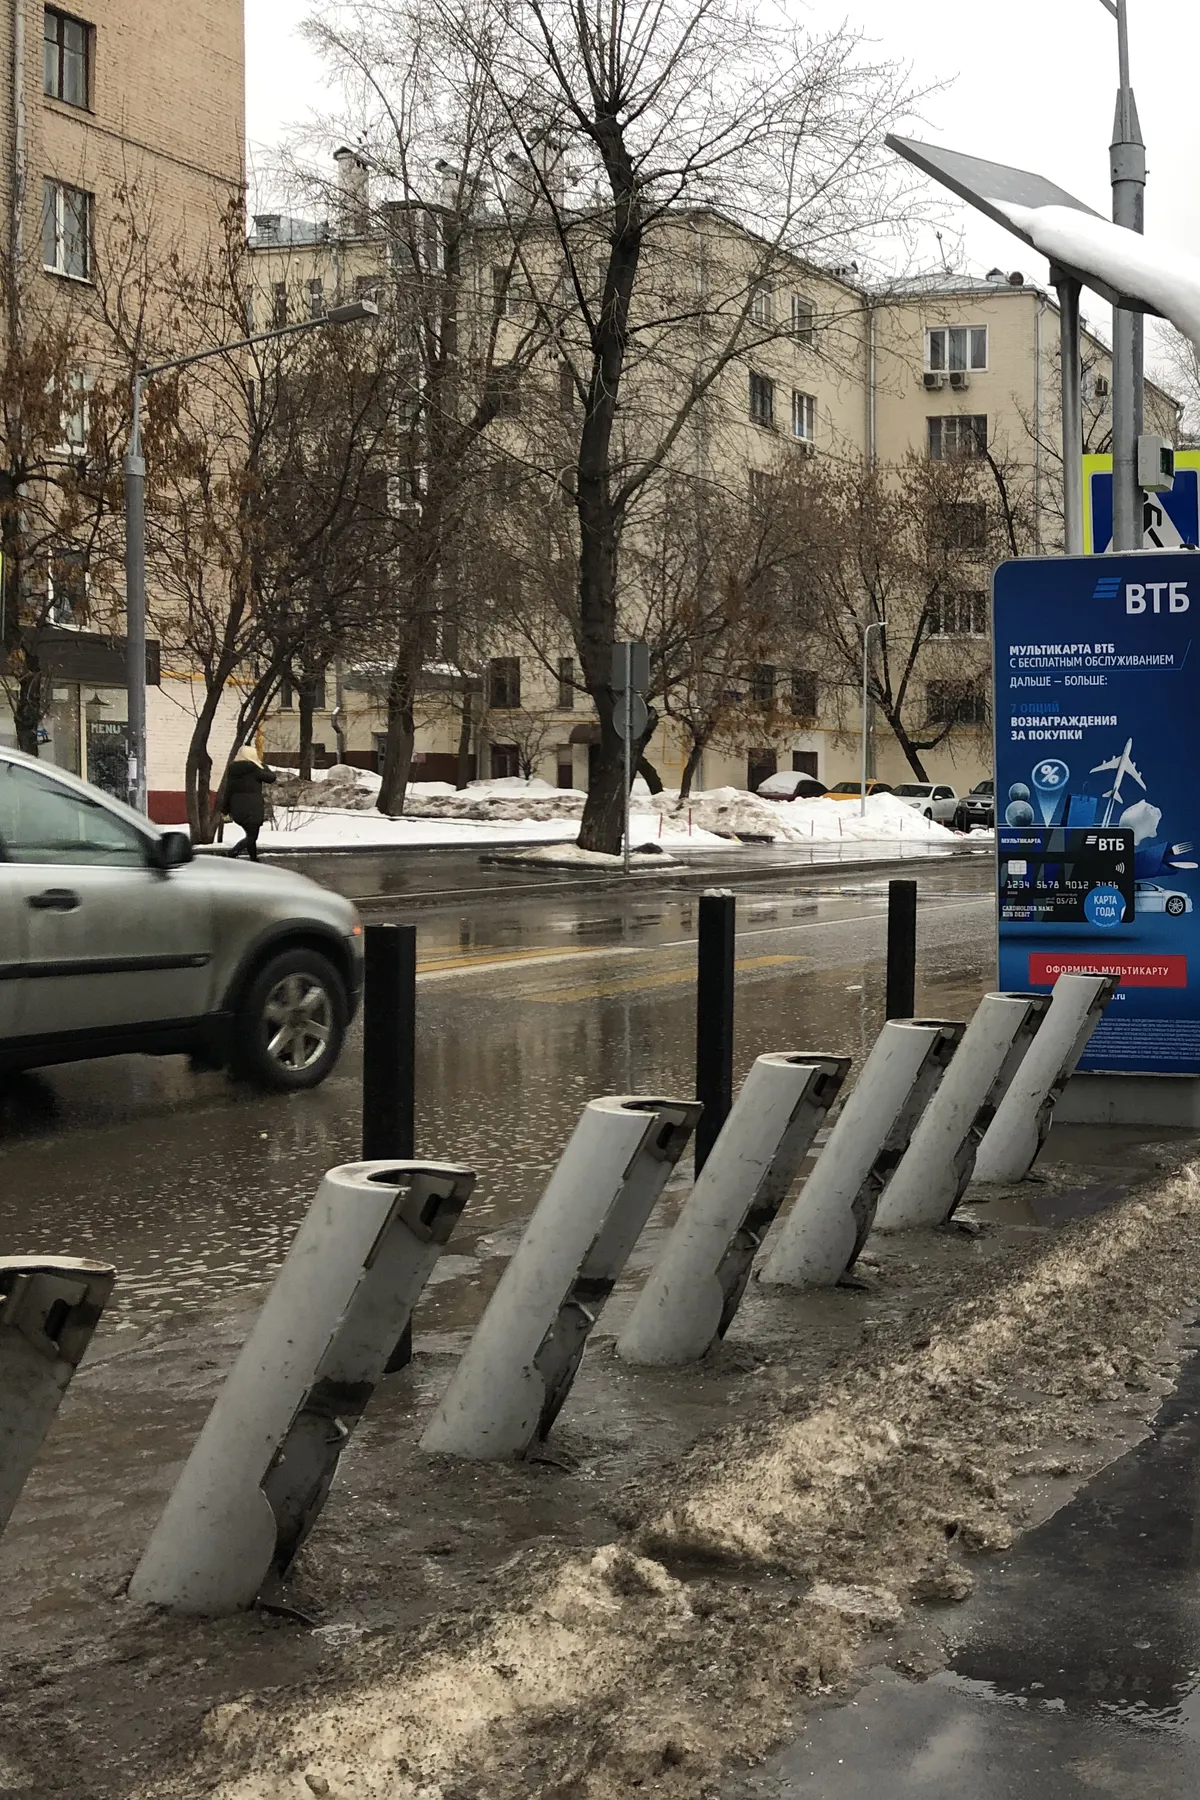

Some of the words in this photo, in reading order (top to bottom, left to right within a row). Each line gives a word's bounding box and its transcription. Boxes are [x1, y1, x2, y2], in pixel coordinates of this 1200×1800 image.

[1125, 582, 1190, 615] ВТБ
[1009, 644, 1092, 656] МУЛЬТИКАРТА
[1094, 643, 1115, 654] ВТБ
[1009, 658, 1016, 668] С
[1018, 656, 1083, 668] БЕСПЛАТНЫМ
[1085, 654, 1174, 667] ОБСЛУЖИВАНИЕМ
[1009, 676, 1052, 689] ДАЛЬШЕ
[1064, 675, 1108, 686] БОЛЬШЕ:
[1011, 703, 1017, 713] 7
[1020, 701, 1060, 714] ОПЦИЙ
[1010, 715, 1118, 728] ВОЗНАГРАЖДЕНИЯ
[91, 723, 121, 734] MENU
[1010, 730, 1026, 740] ЗА
[1028, 729, 1083, 741] ПОКУПКИ
[1000, 837, 1042, 845] МУЛЬТИКАРТА
[1098, 838, 1125, 851] ВТБ
[1006, 880, 1030, 889] 1234
[1036, 880, 1060, 889] 5678
[1065, 881, 1089, 890] 9012
[1056, 897, 1078, 905] 05/21
[1093, 895, 1118, 905] КАРТА
[1095, 907, 1116, 918] ГОДА
[1045, 964, 1099, 974] ОФОРМИТЬ
[1101, 965, 1169, 976] МУЛЬТИКАРТУ
